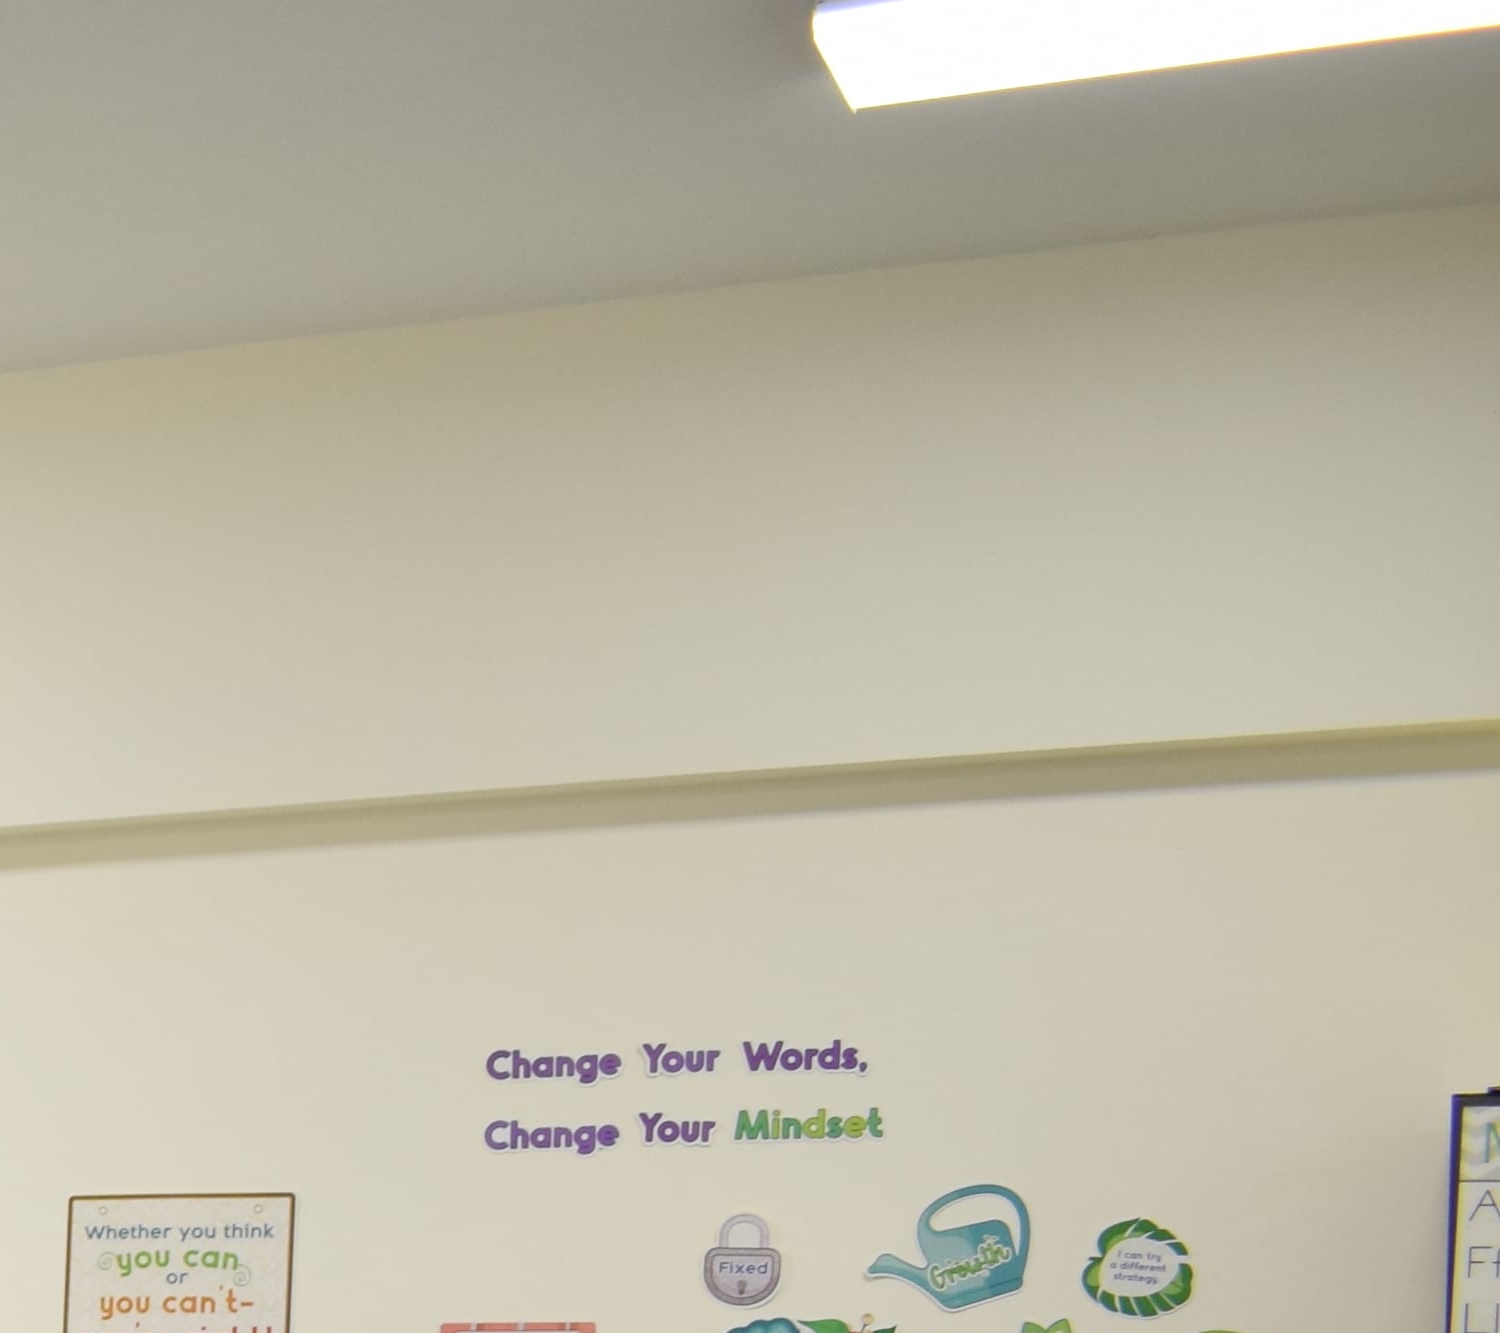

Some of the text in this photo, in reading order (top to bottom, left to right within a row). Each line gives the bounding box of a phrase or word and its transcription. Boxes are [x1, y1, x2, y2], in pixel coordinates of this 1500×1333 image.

[486, 1040, 868, 1084] Change Your Words,
[484, 1108, 883, 1155] Change Your Mindset
[86, 1222, 274, 1243] Whether you think
[117, 1250, 239, 1276] you can
[718, 1261, 768, 1275] Fixed
[929, 1235, 1011, 1290] Growth
[1120, 1262, 1166, 1272] different
[166, 1271, 188, 1284] or
[100, 1295, 149, 1319] you
